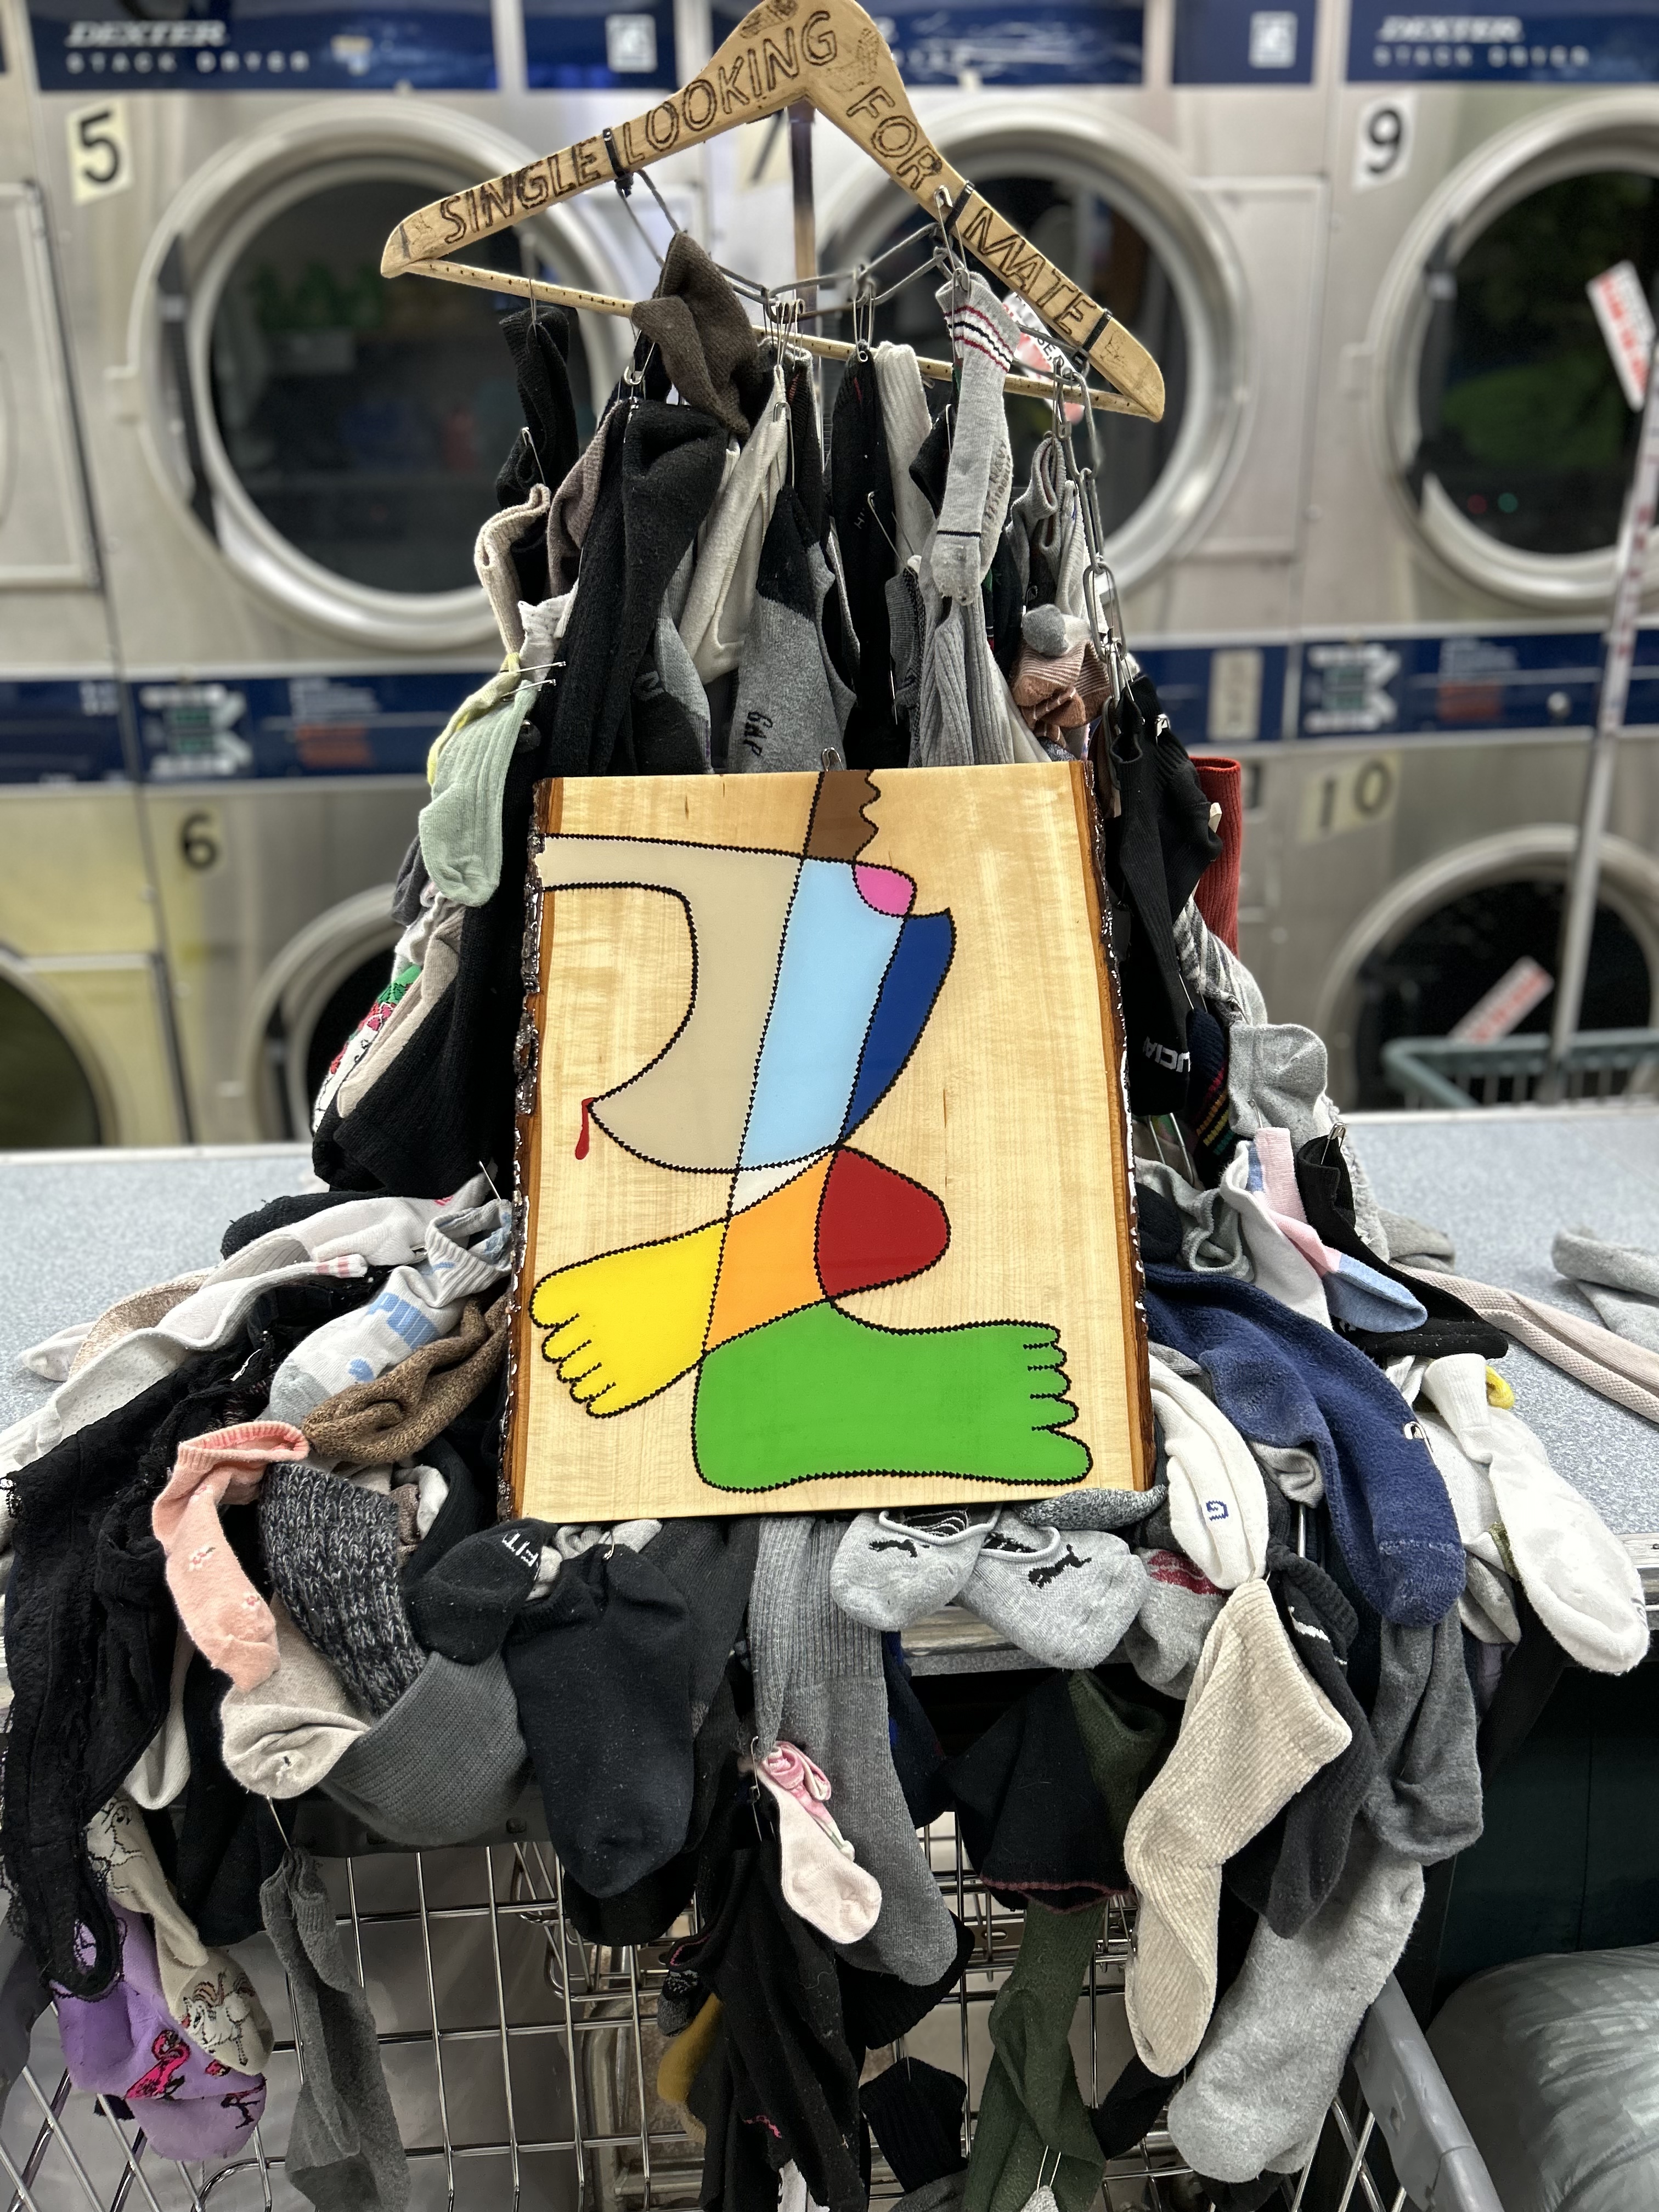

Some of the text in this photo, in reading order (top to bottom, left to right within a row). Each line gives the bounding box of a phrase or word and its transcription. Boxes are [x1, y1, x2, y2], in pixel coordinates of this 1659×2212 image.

[79, 111, 121, 184] 5
[440, 137, 601, 245] SINGLE
[623, 11, 837, 165] LOOKING
[845, 86, 943, 191] FOR
[963, 206, 1097, 335] MATE
[1368, 108, 1403, 174] 9
[743, 712, 774, 757] GAP
[1322, 759, 1392, 828] 10
[179, 812, 217, 870] 6
